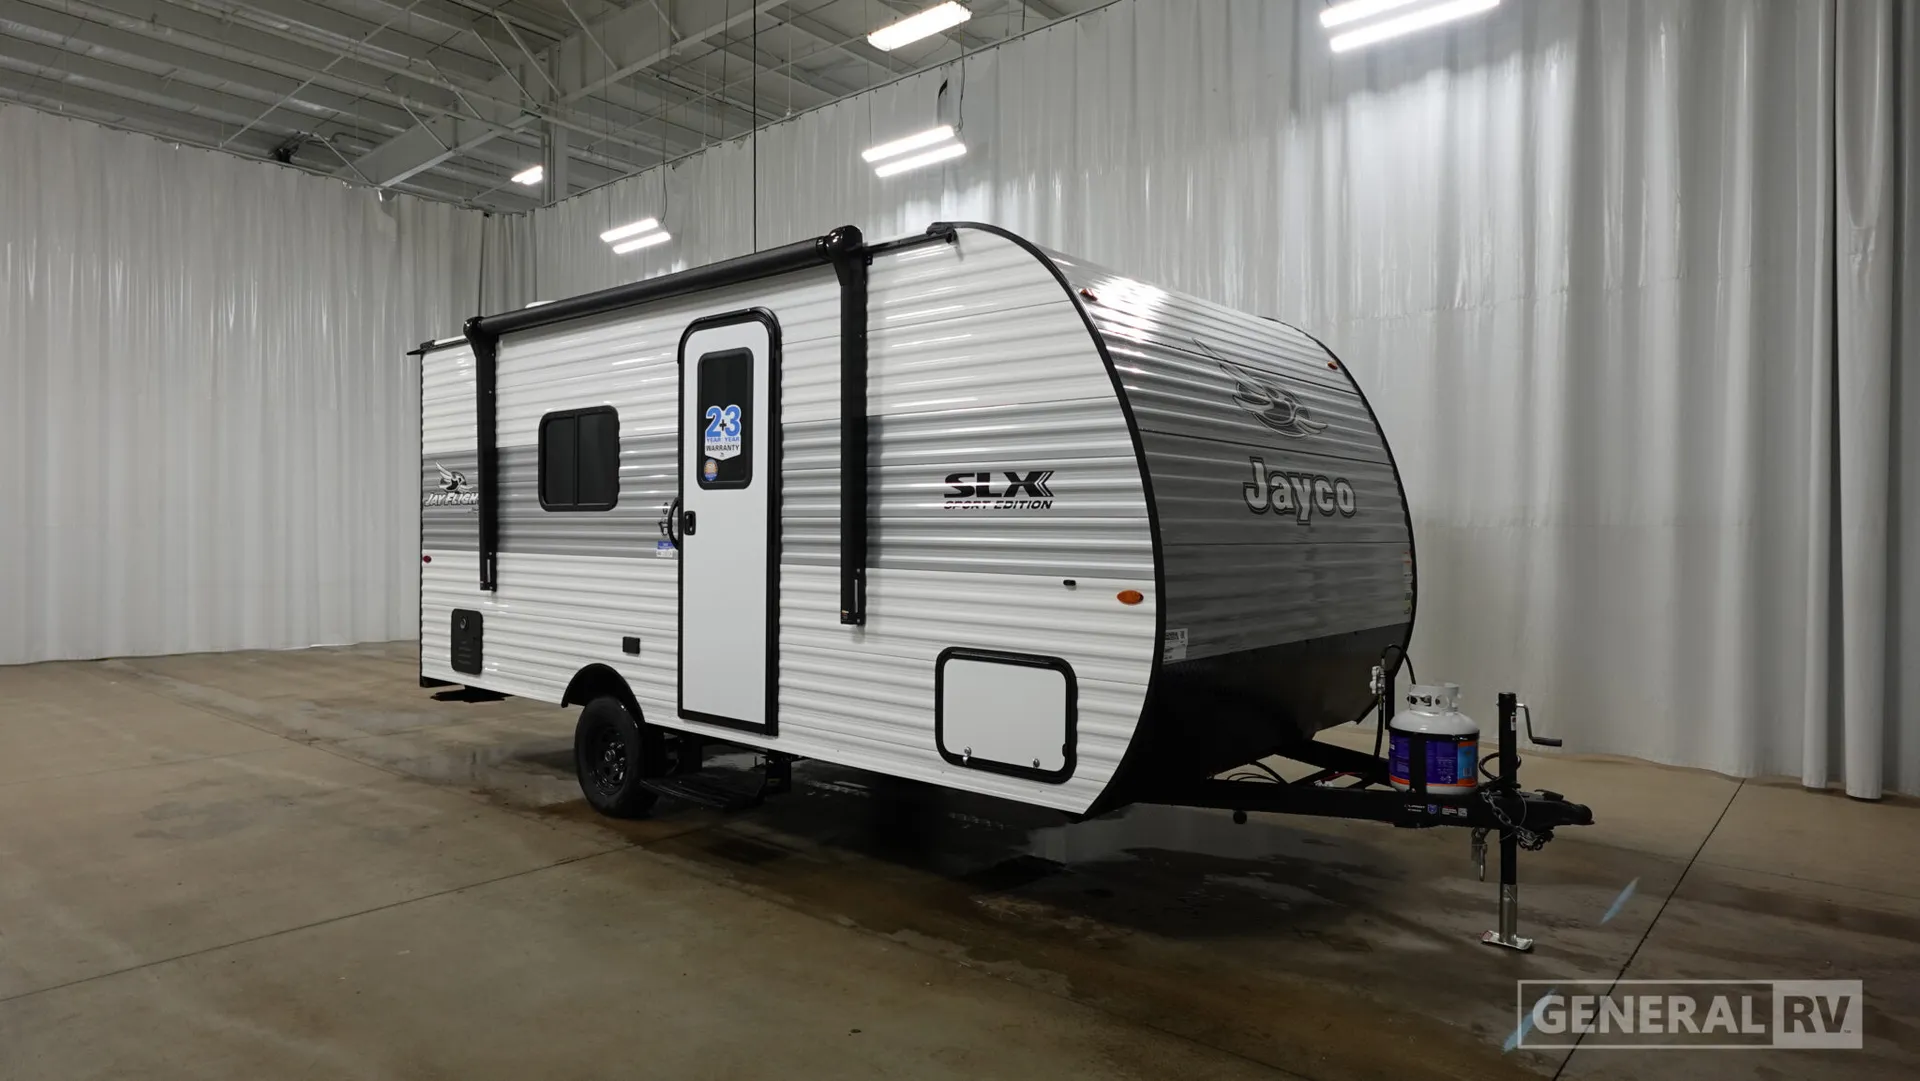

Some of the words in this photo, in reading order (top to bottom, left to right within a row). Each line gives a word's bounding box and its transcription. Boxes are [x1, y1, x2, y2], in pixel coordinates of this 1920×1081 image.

[944, 471, 1054, 498] SLX
[1243, 456, 1357, 526] Jayco
[424, 493, 446, 507] JAY
[444, 492, 479, 506] FLIGH
[944, 500, 991, 510] SPORT
[994, 500, 1054, 510] EDITION
